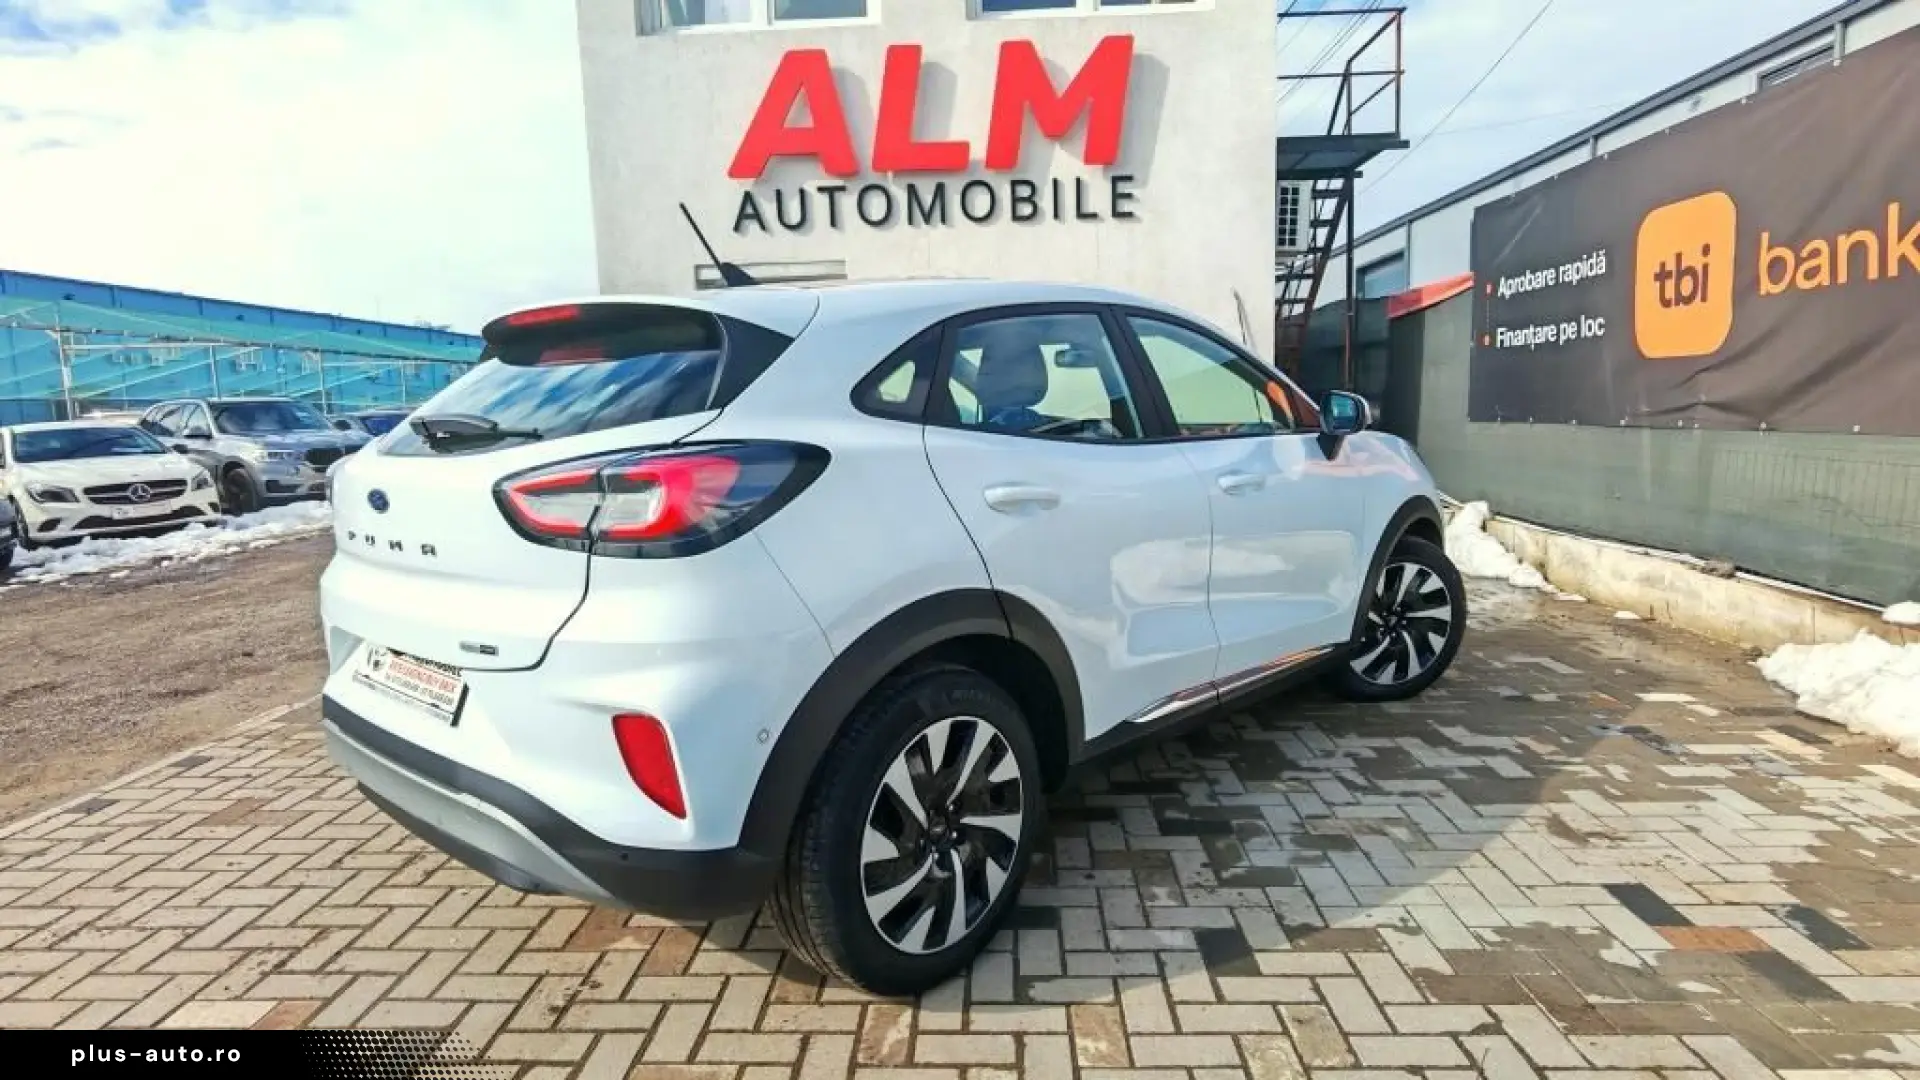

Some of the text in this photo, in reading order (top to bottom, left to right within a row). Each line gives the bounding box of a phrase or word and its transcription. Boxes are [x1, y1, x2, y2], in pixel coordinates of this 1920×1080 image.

[728, 35, 1134, 178] ALM
[733, 175, 1135, 233] AUTOMOBILE
[1498, 249, 1606, 300] Aprobare rapidă
[1653, 202, 1920, 308] tbi bank
[1559, 321, 1578, 346] pe
[1580, 315, 1605, 338] loc
